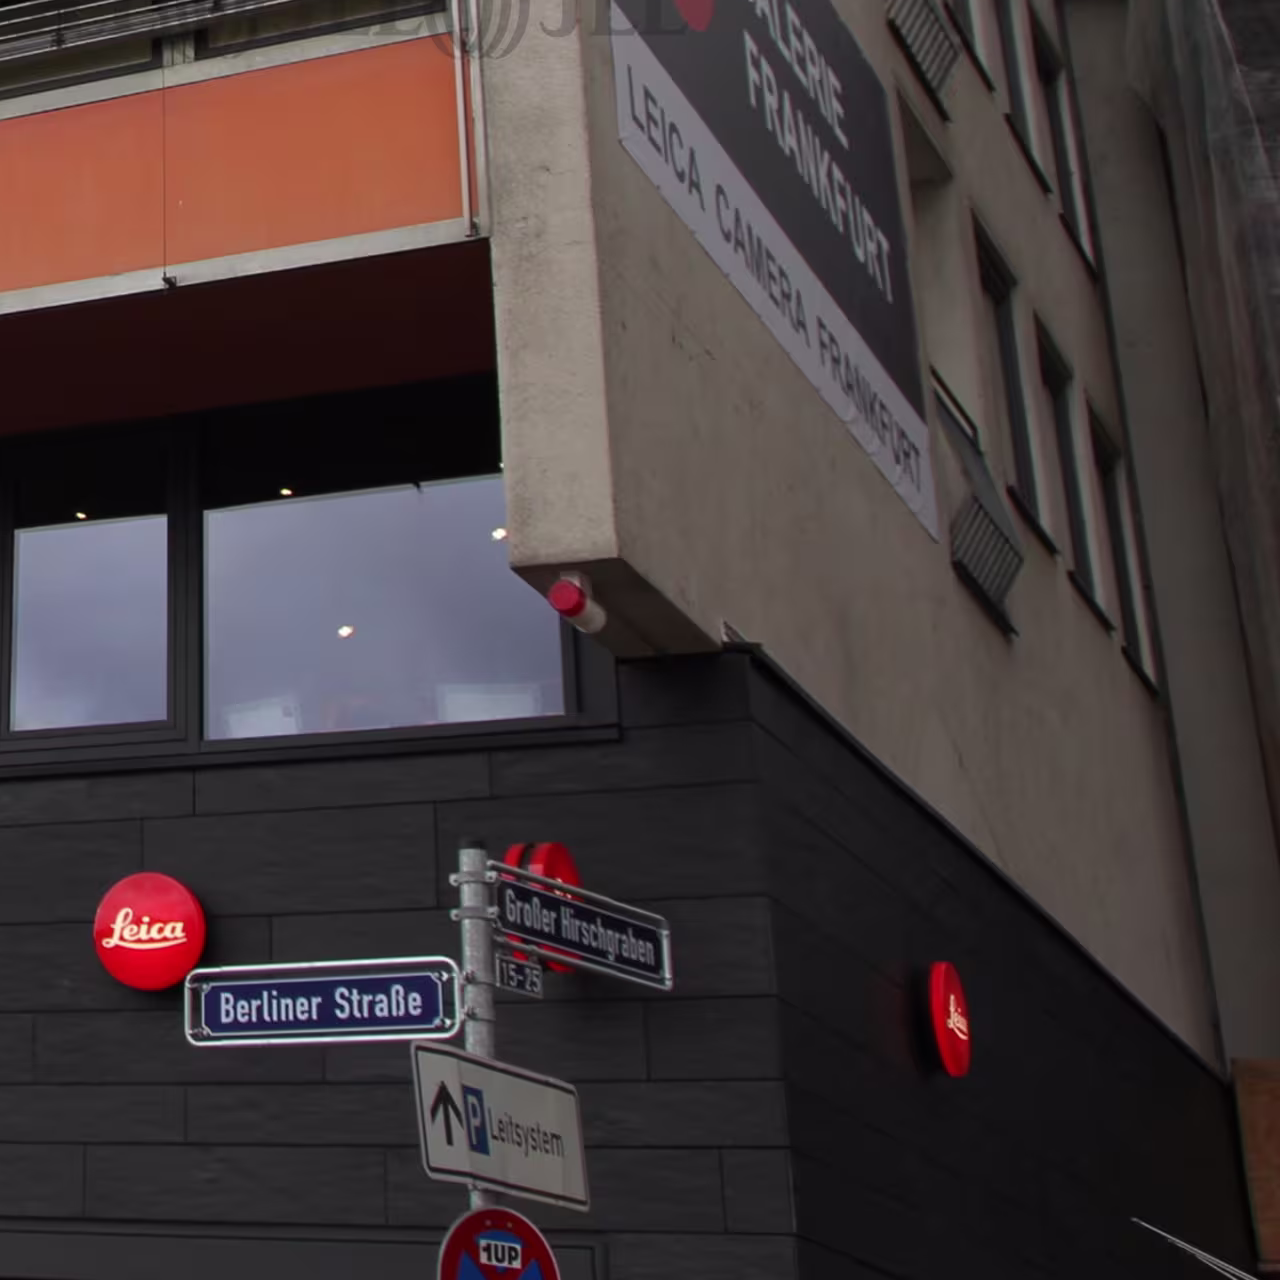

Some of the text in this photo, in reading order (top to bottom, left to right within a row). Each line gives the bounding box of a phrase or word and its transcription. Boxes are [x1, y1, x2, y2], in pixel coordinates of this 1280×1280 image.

[743, 29, 893, 304] FRANKFURT
[626, 64, 923, 494] LEICA CAMERA FRANKFURT
[102, 907, 188, 951] Leica
[504, 888, 558, 938] Großer
[560, 905, 656, 967] Hirschgraben
[500, 960, 541, 993] 15-25
[220, 984, 424, 1025] Berliner Straße
[487, 1106, 566, 1159] Leitsystem
[482, 1242, 520, 1265] 1UP
